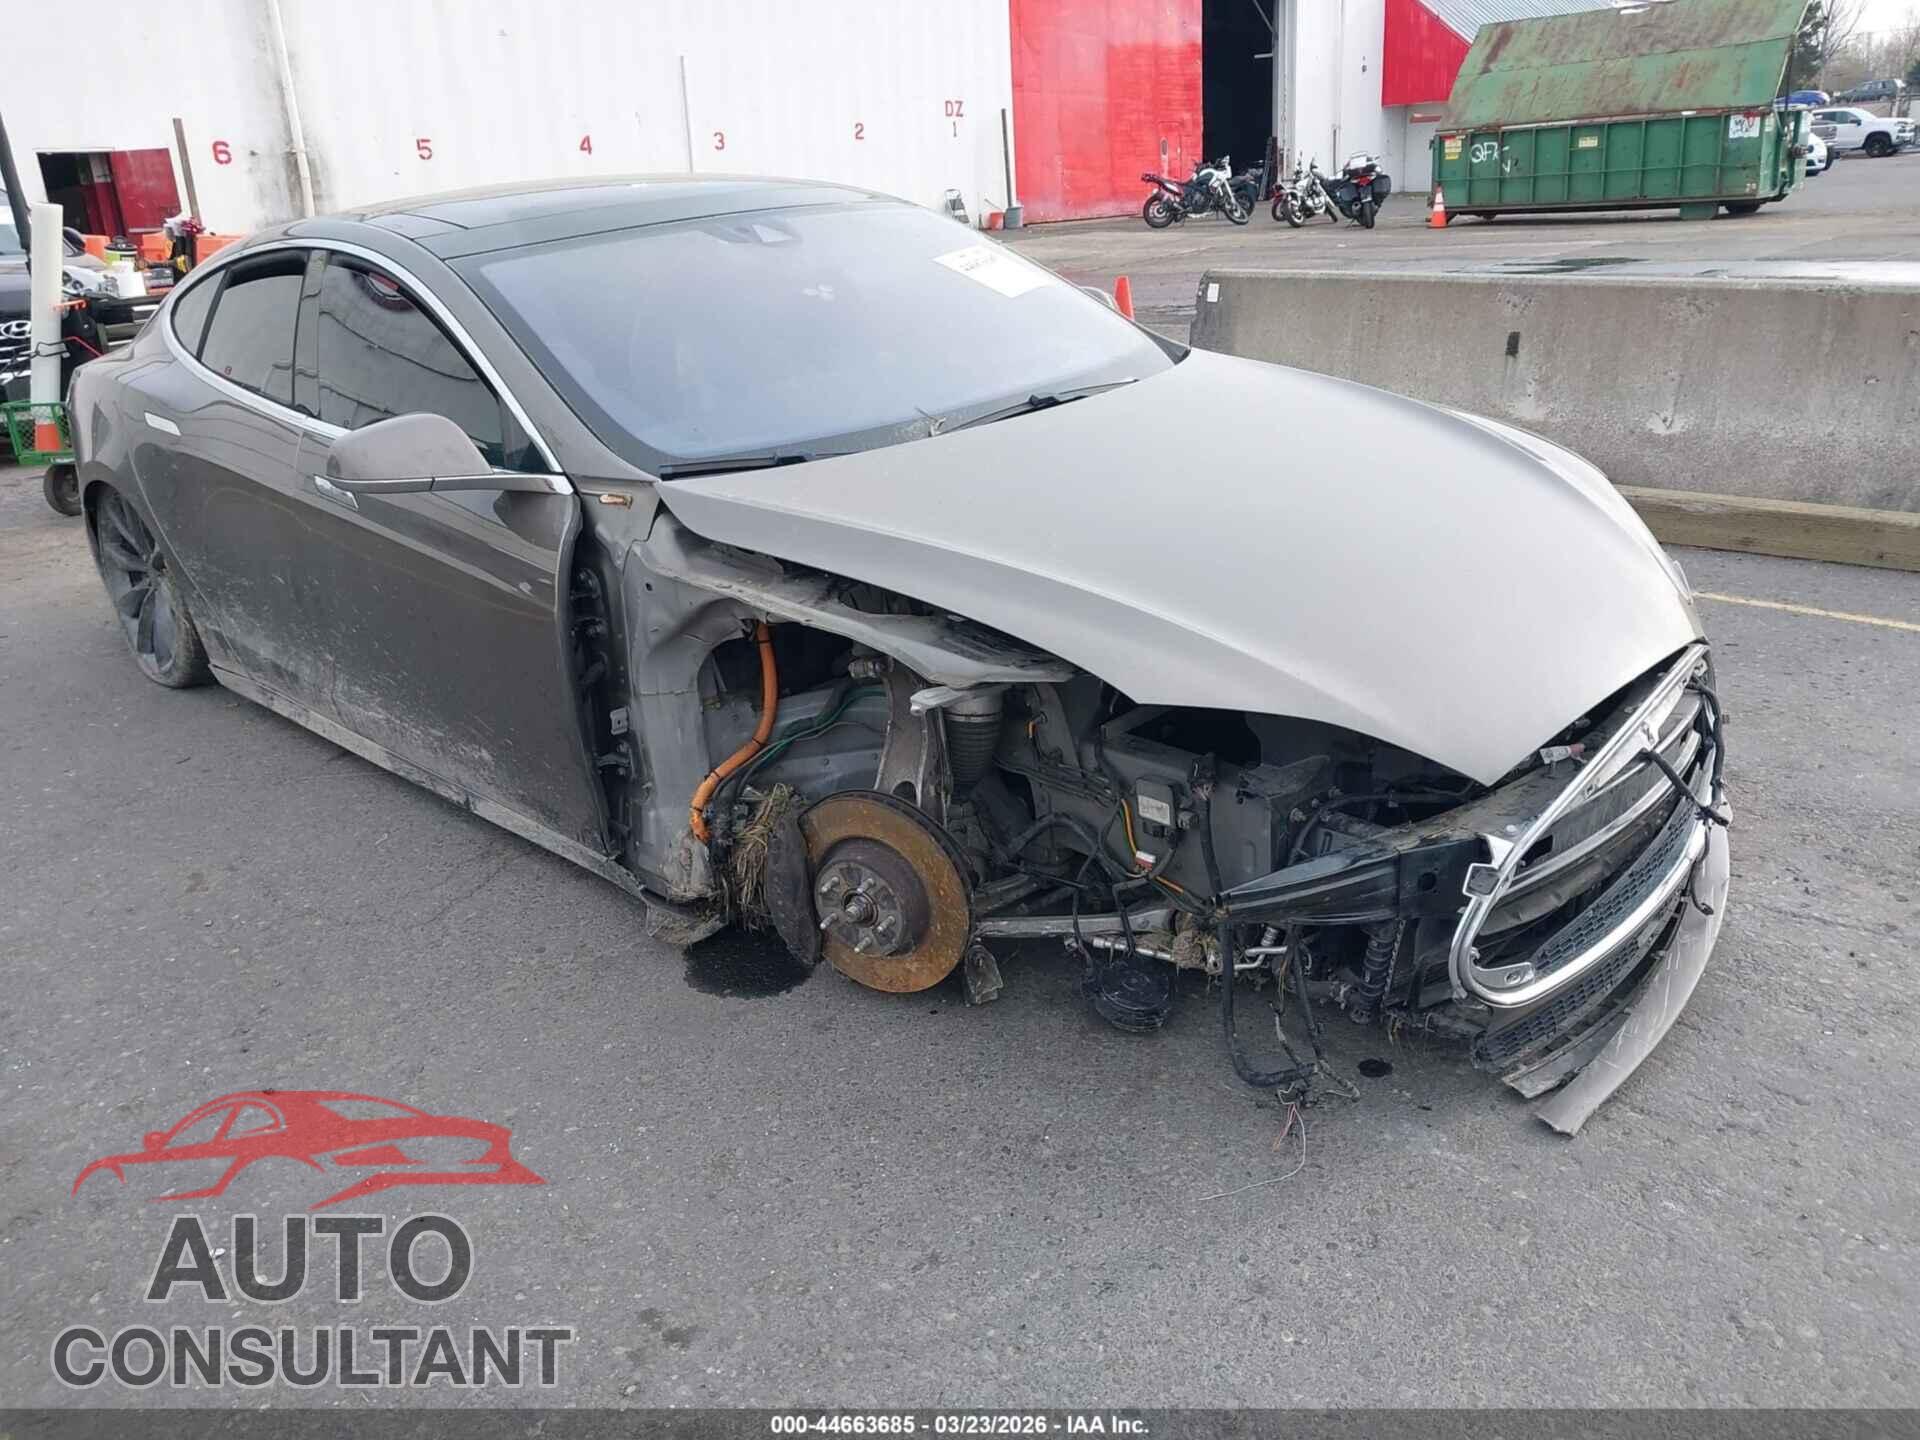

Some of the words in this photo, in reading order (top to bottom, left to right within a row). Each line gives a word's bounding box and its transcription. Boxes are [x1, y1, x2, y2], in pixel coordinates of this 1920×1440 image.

[944, 100, 964, 118] DZ
[854, 122, 865, 140] 2
[952, 120, 958, 138] 1
[416, 139, 432, 160] 5
[580, 135, 593, 155] 4
[713, 131, 725, 150] 3
[212, 140, 232, 165] 6
